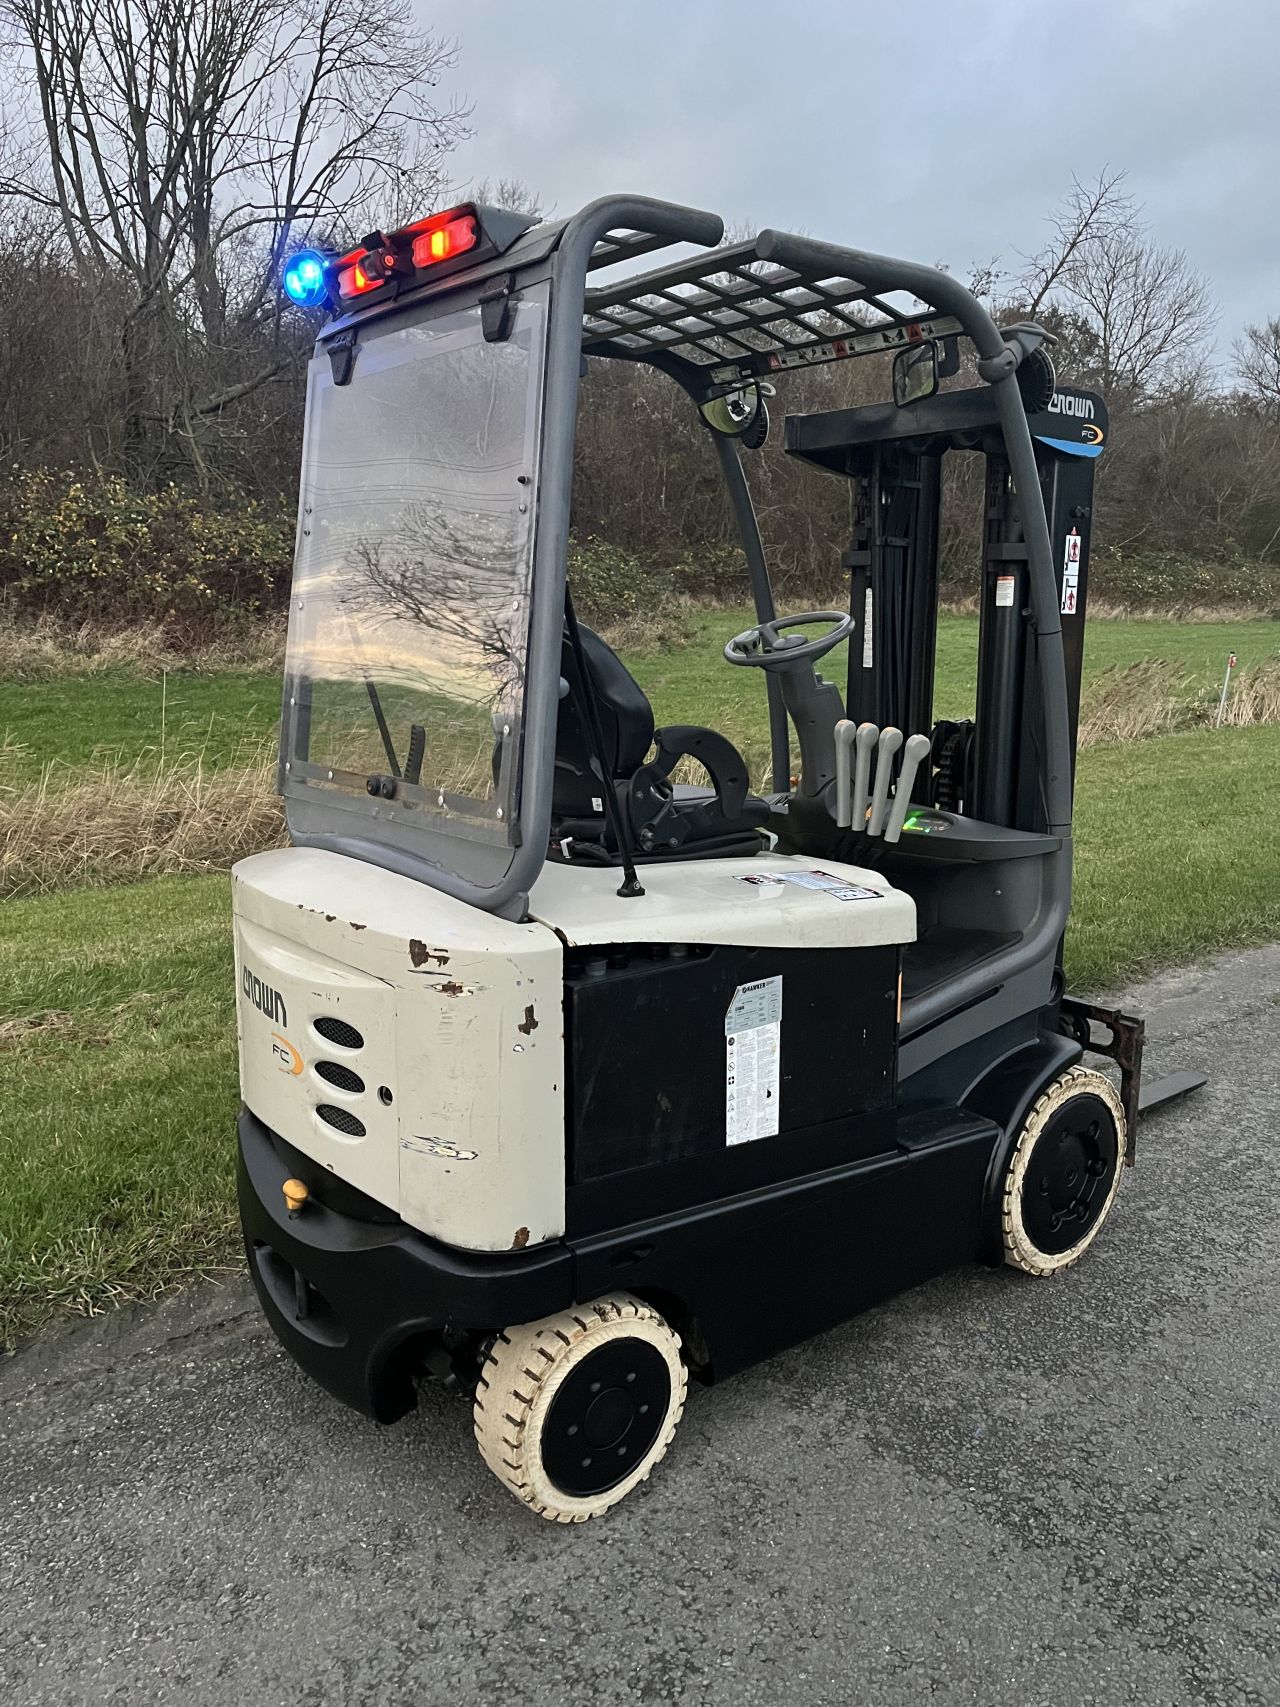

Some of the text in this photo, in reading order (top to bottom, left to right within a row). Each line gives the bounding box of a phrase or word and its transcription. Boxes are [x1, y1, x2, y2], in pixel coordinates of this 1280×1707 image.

[1047, 393, 1095, 419] CROWN
[1081, 430, 1095, 439] FC
[243, 964, 287, 1028] CROWN
[272, 1043, 290, 1065] FC
